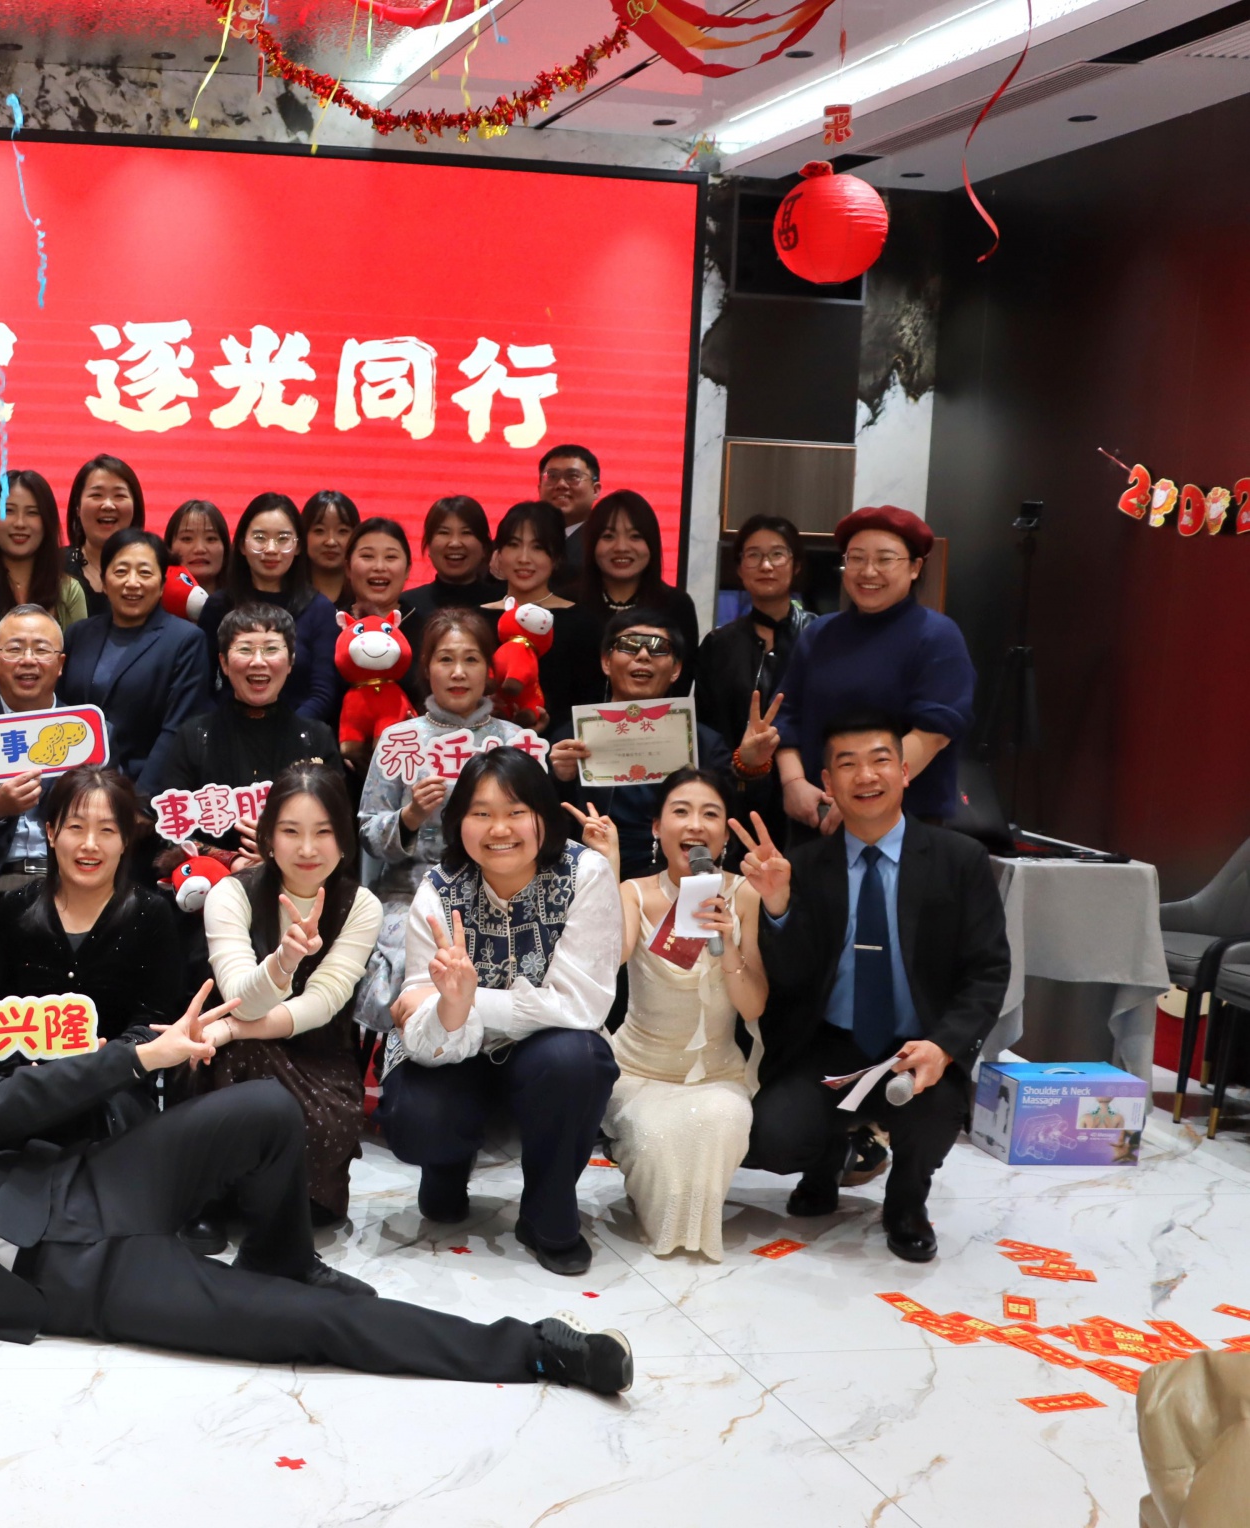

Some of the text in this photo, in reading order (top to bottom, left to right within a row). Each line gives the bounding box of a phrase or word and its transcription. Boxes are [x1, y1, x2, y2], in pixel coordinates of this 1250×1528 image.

[84, 319, 559, 449] 逐光同行
[614, 720, 657, 736] 奖状
[380, 730, 545, 781] 乔迁
[1023, 1086, 1092, 1096] Shoulder & Neck
[1022, 1095, 1063, 1107] Massager
